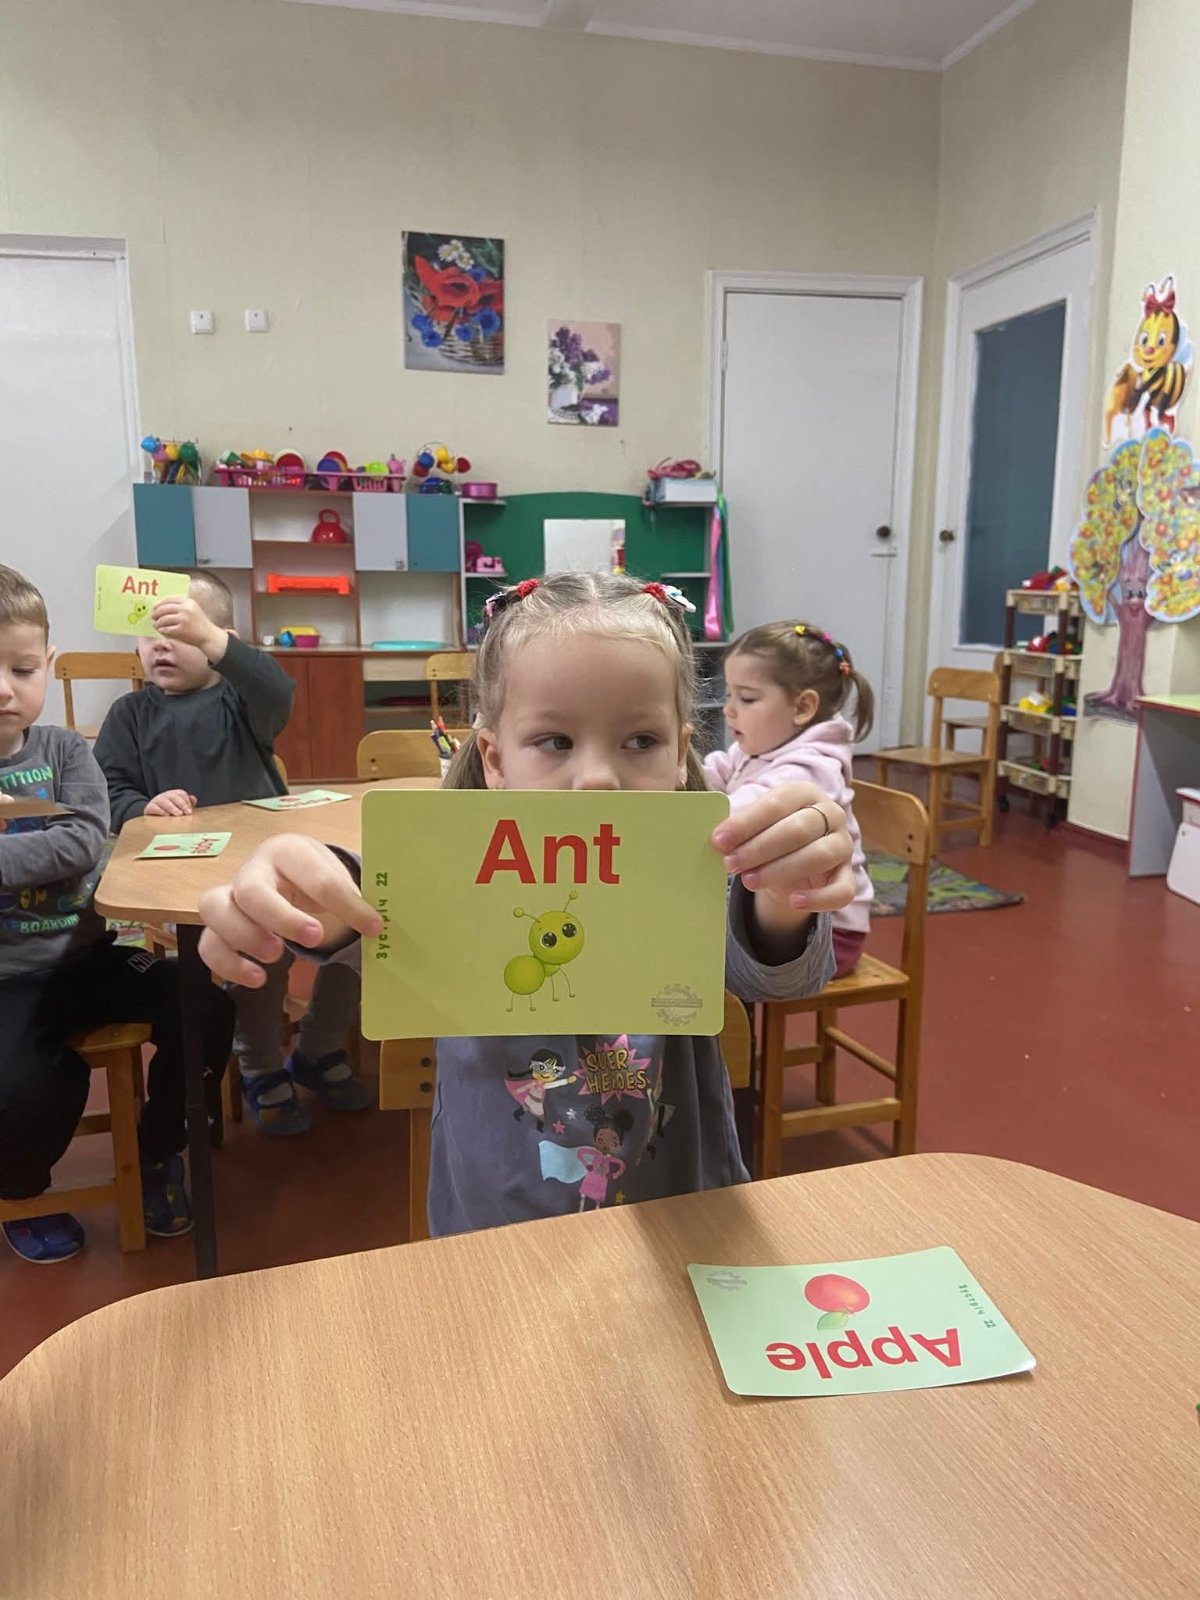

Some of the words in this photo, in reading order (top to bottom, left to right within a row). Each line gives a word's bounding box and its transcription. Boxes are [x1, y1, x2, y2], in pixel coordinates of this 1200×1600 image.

[121, 575, 159, 596] Ant
[475, 819, 621, 885] Ant
[375, 871, 389, 887] 22
[375, 898, 391, 960] Зусріч
[584, 1047, 630, 1072] SUER
[983, 1319, 996, 1328] 22
[765, 1325, 962, 1379] Apple
